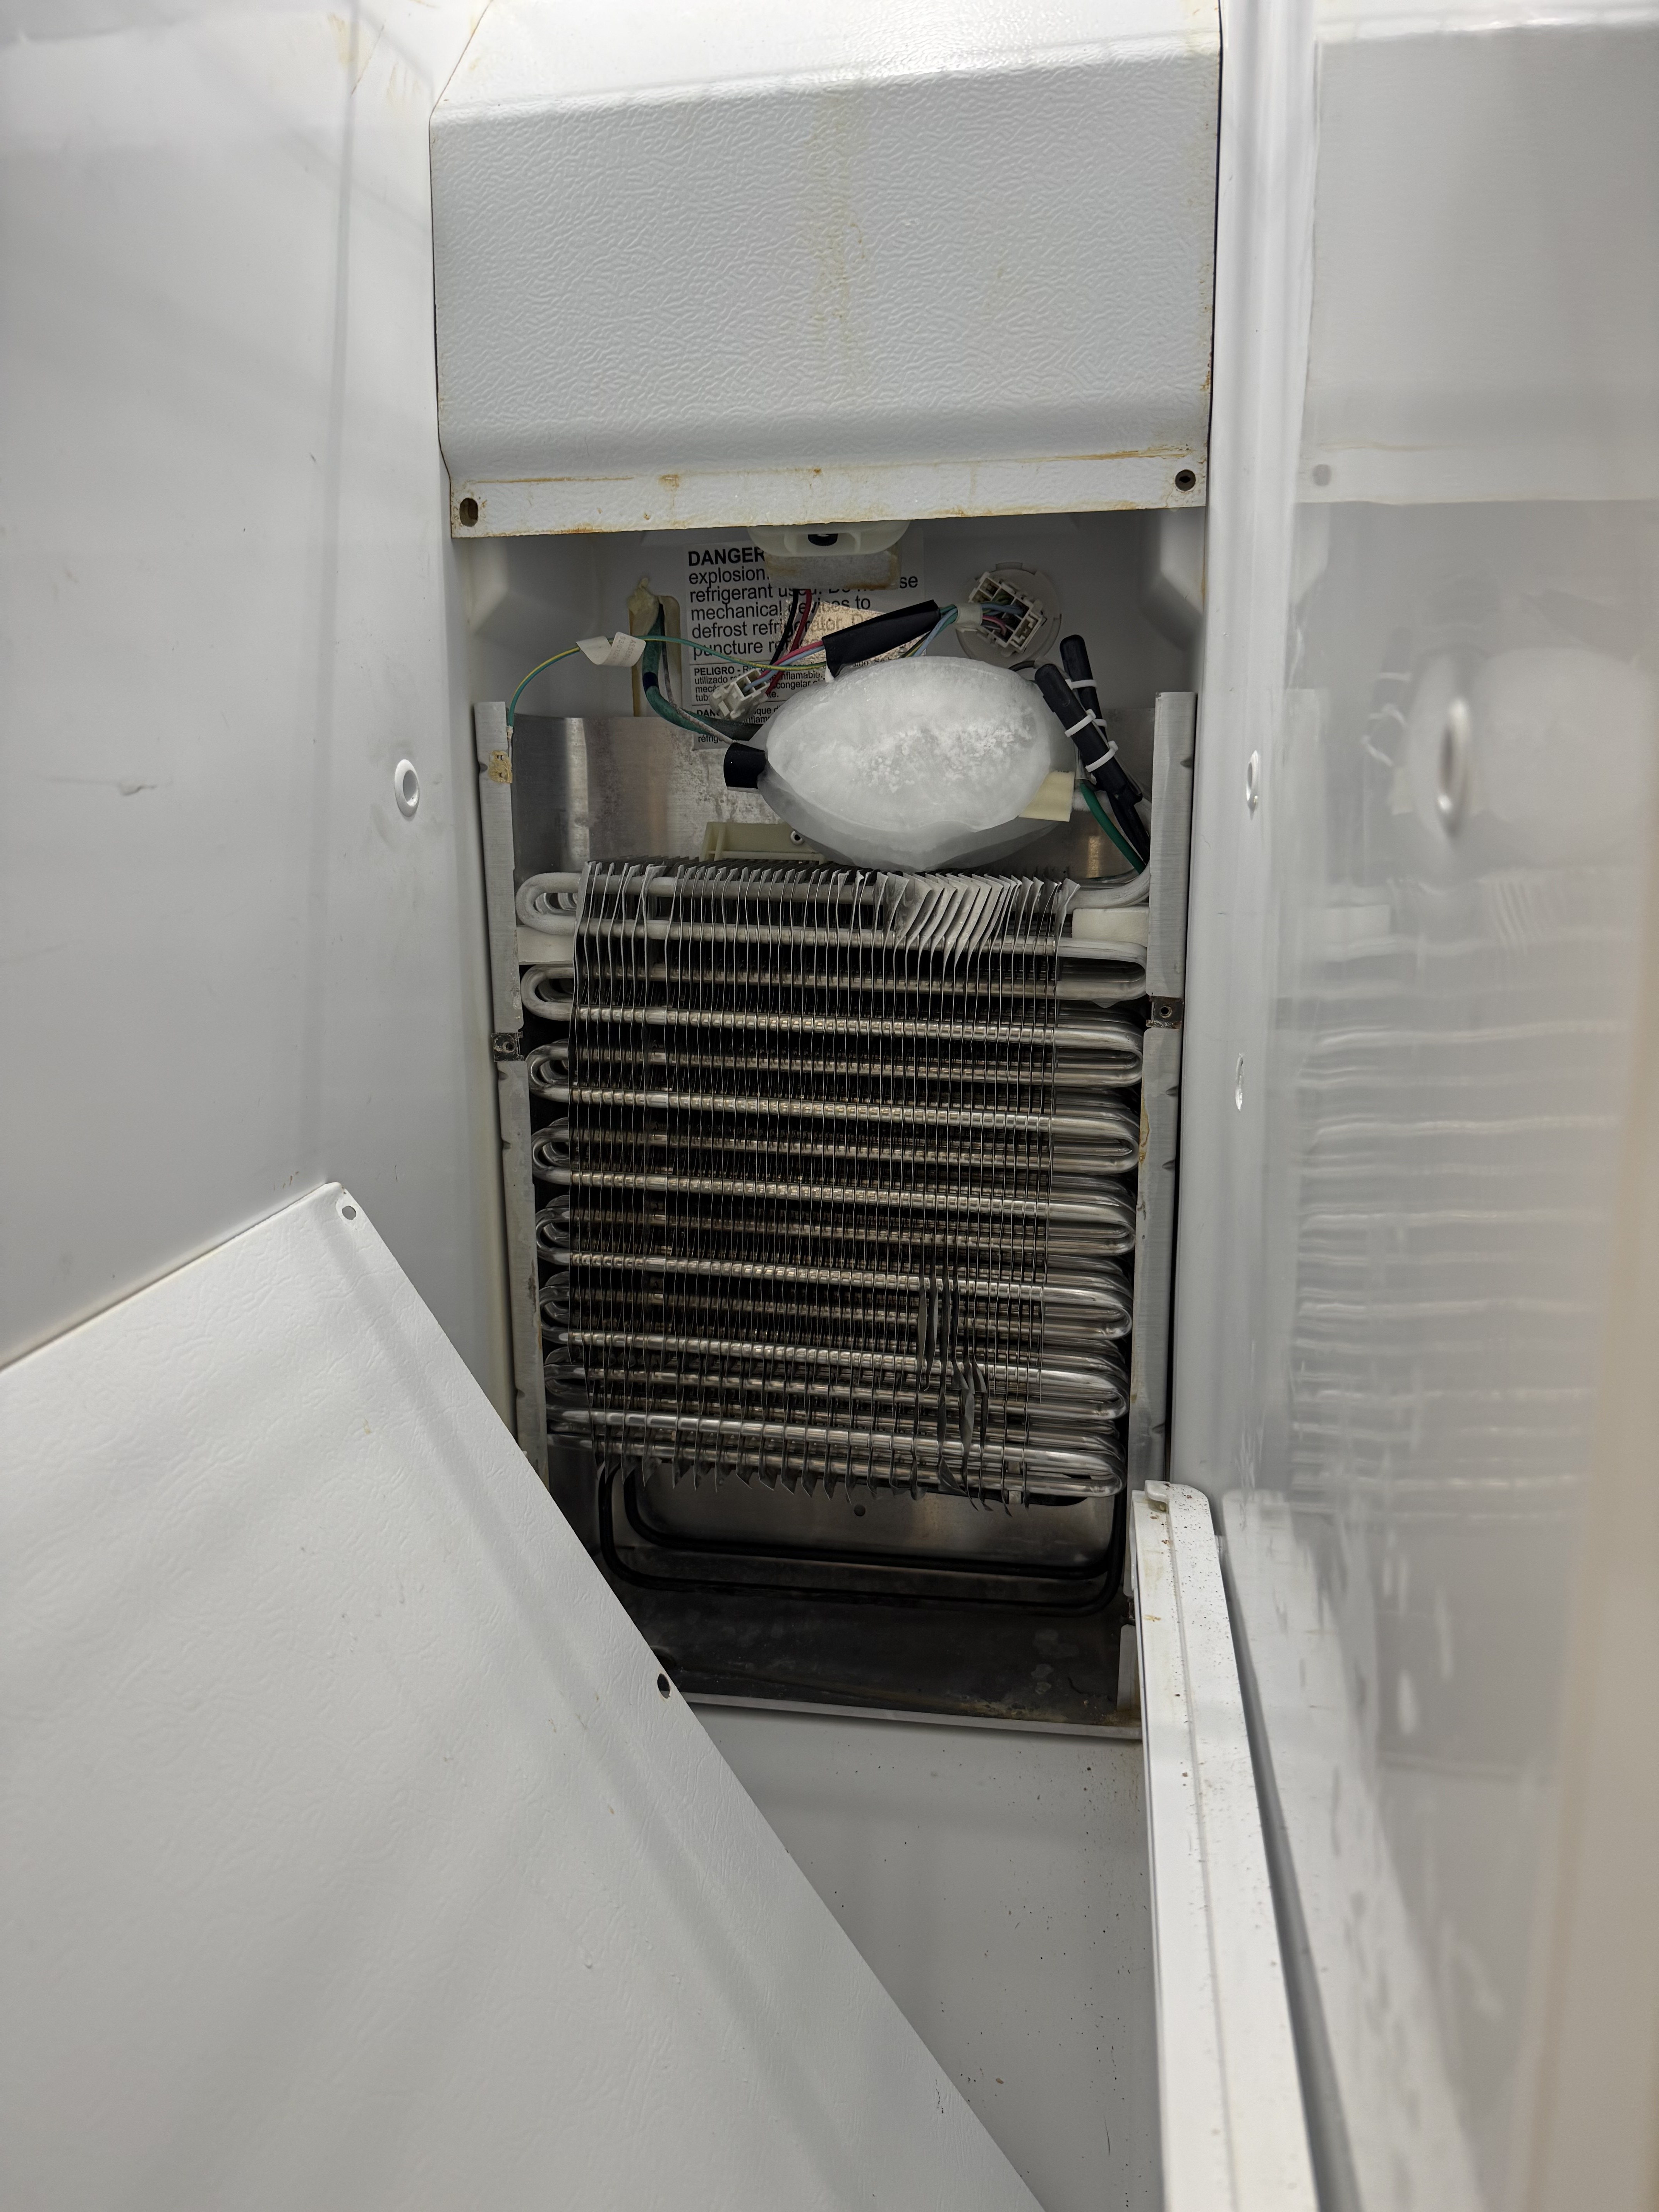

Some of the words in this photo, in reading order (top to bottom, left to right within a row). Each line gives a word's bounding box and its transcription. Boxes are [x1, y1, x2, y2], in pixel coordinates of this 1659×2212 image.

[688, 546, 765, 567] DANGER
[690, 583, 773, 605] refrigerant
[691, 600, 781, 621] mechanical
[855, 595, 871, 610] to
[692, 621, 748, 639] defrost
[694, 666, 735, 676] PELIGRO
[780, 670, 823, 680] nflamable.
[695, 675, 728, 684] utilizado
[775, 680, 811, 690] congelar
